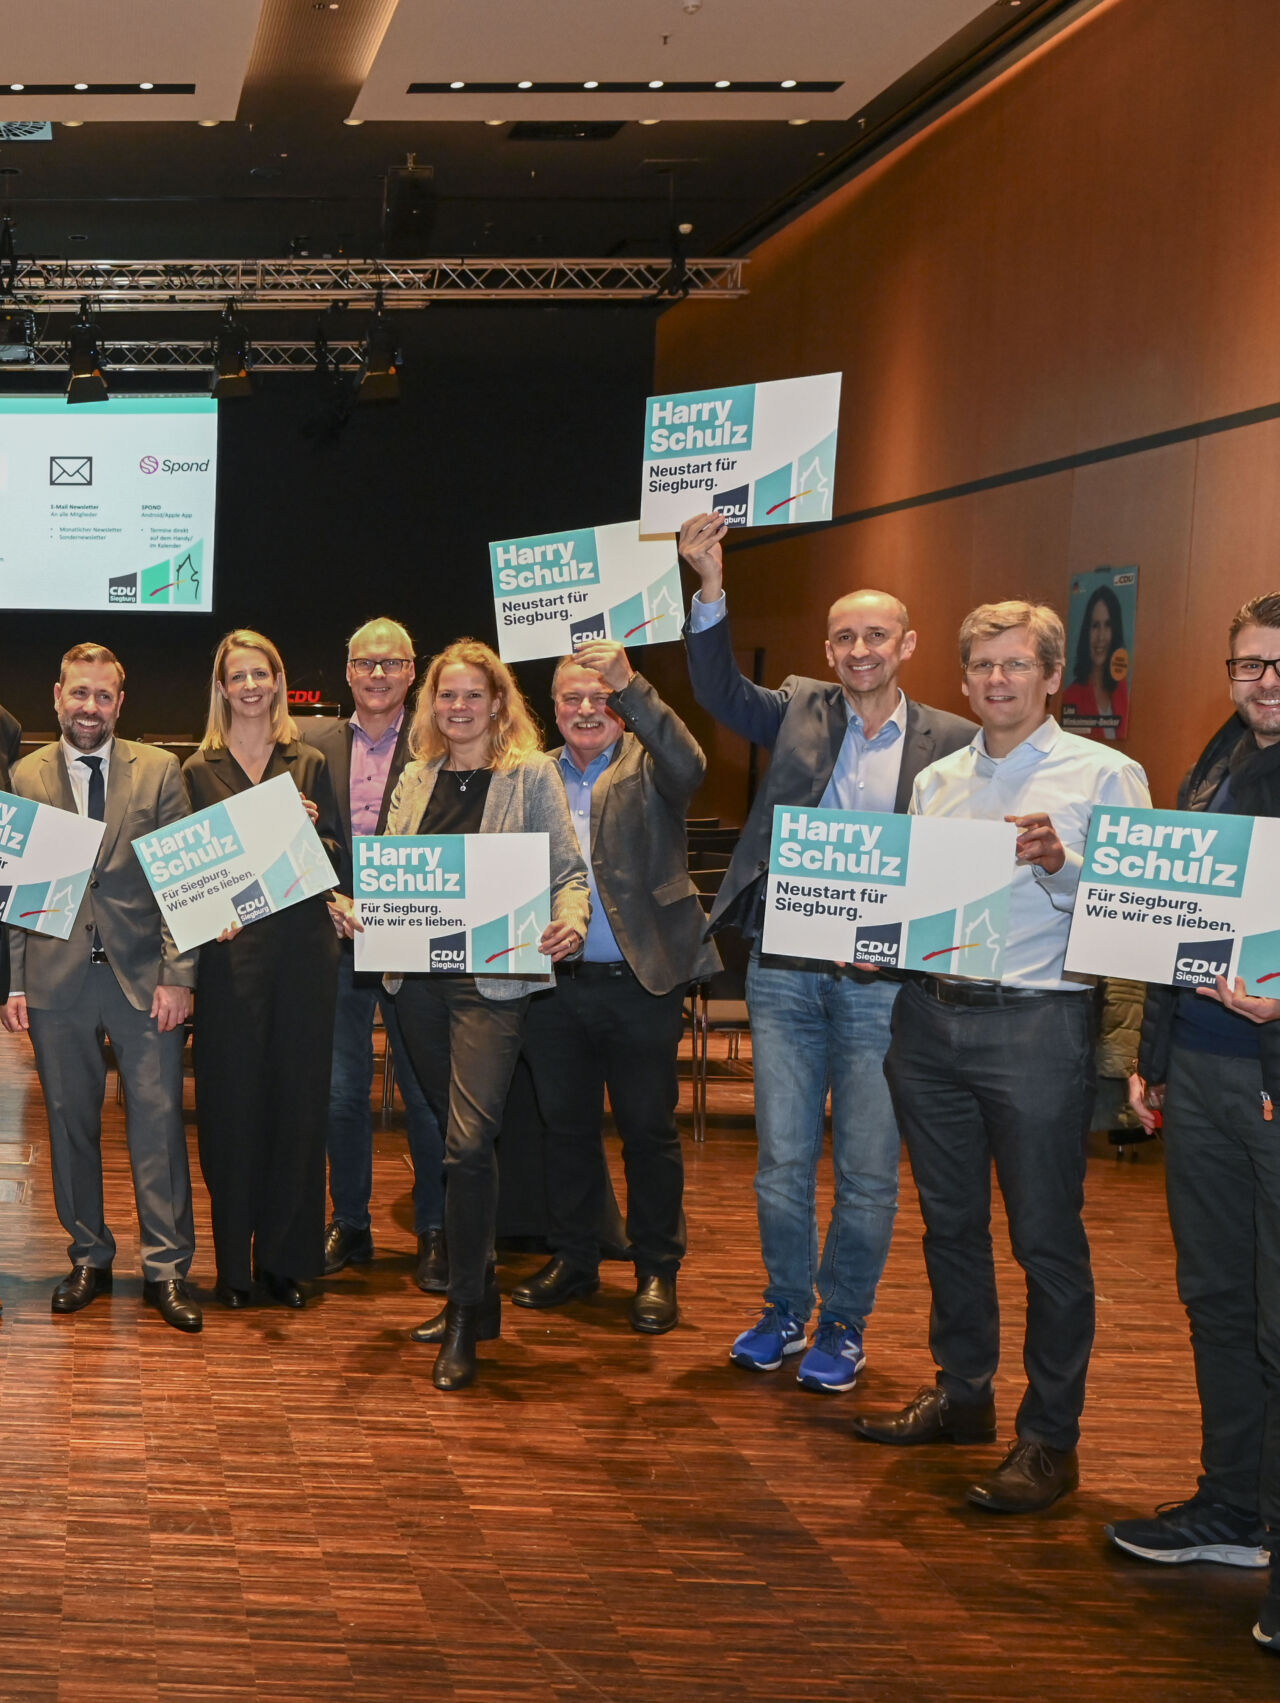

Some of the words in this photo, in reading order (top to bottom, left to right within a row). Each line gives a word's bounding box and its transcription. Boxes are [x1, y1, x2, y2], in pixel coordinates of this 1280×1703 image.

[652, 400, 733, 426] Harry
[650, 421, 748, 452] Schulz
[162, 459, 210, 474] Spond
[650, 461, 711, 478] Neustart
[716, 458, 737, 471] für
[649, 477, 717, 494] Siegburg.
[724, 516, 746, 525] gburg
[496, 541, 575, 568] Harry
[499, 560, 594, 590] Schulz
[110, 586, 136, 595] CDU
[502, 595, 564, 612] Neustart
[568, 592, 588, 603] für
[504, 608, 572, 626] Siegburg.
[572, 630, 605, 643] CDU
[287, 690, 321, 702] CDU
[139, 819, 211, 863] Harry
[781, 812, 883, 851] Harry
[1096, 814, 1218, 858] Harry
[150, 834, 239, 883] Schulz
[359, 843, 442, 871] Harry
[778, 841, 902, 877] Schulz
[1091, 847, 1238, 887] Schulz
[162, 889, 180, 902] Für
[181, 867, 230, 894] Siegburg.
[359, 868, 460, 892] Schulz
[167, 900, 188, 912] Wie
[190, 889, 205, 902] wir
[207, 886, 219, 895] es
[220, 871, 255, 890] lieben.
[776, 881, 856, 902] Neustart
[860, 889, 887, 904] für
[1088, 888, 1115, 902] Für
[1119, 892, 1202, 914] Siegburg.
[237, 895, 265, 915] CDU
[240, 906, 269, 922] Siegburg
[361, 903, 380, 913] Für
[383, 903, 441, 915] Siegburg.
[775, 897, 862, 921] Siegburg.
[361, 916, 385, 926] Wie
[387, 917, 407, 926] wir
[409, 918, 422, 926] es
[425, 916, 466, 927] lieben.
[1086, 904, 1117, 918] Wie
[1122, 911, 1149, 923] wir
[1152, 914, 1173, 925] es
[1176, 915, 1236, 933] lieben.
[431, 950, 464, 961] CDU
[856, 940, 898, 955] CDU
[431, 961, 464, 970] Siegburg
[856, 952, 896, 965] Siegburg
[1176, 958, 1228, 975] CDU
